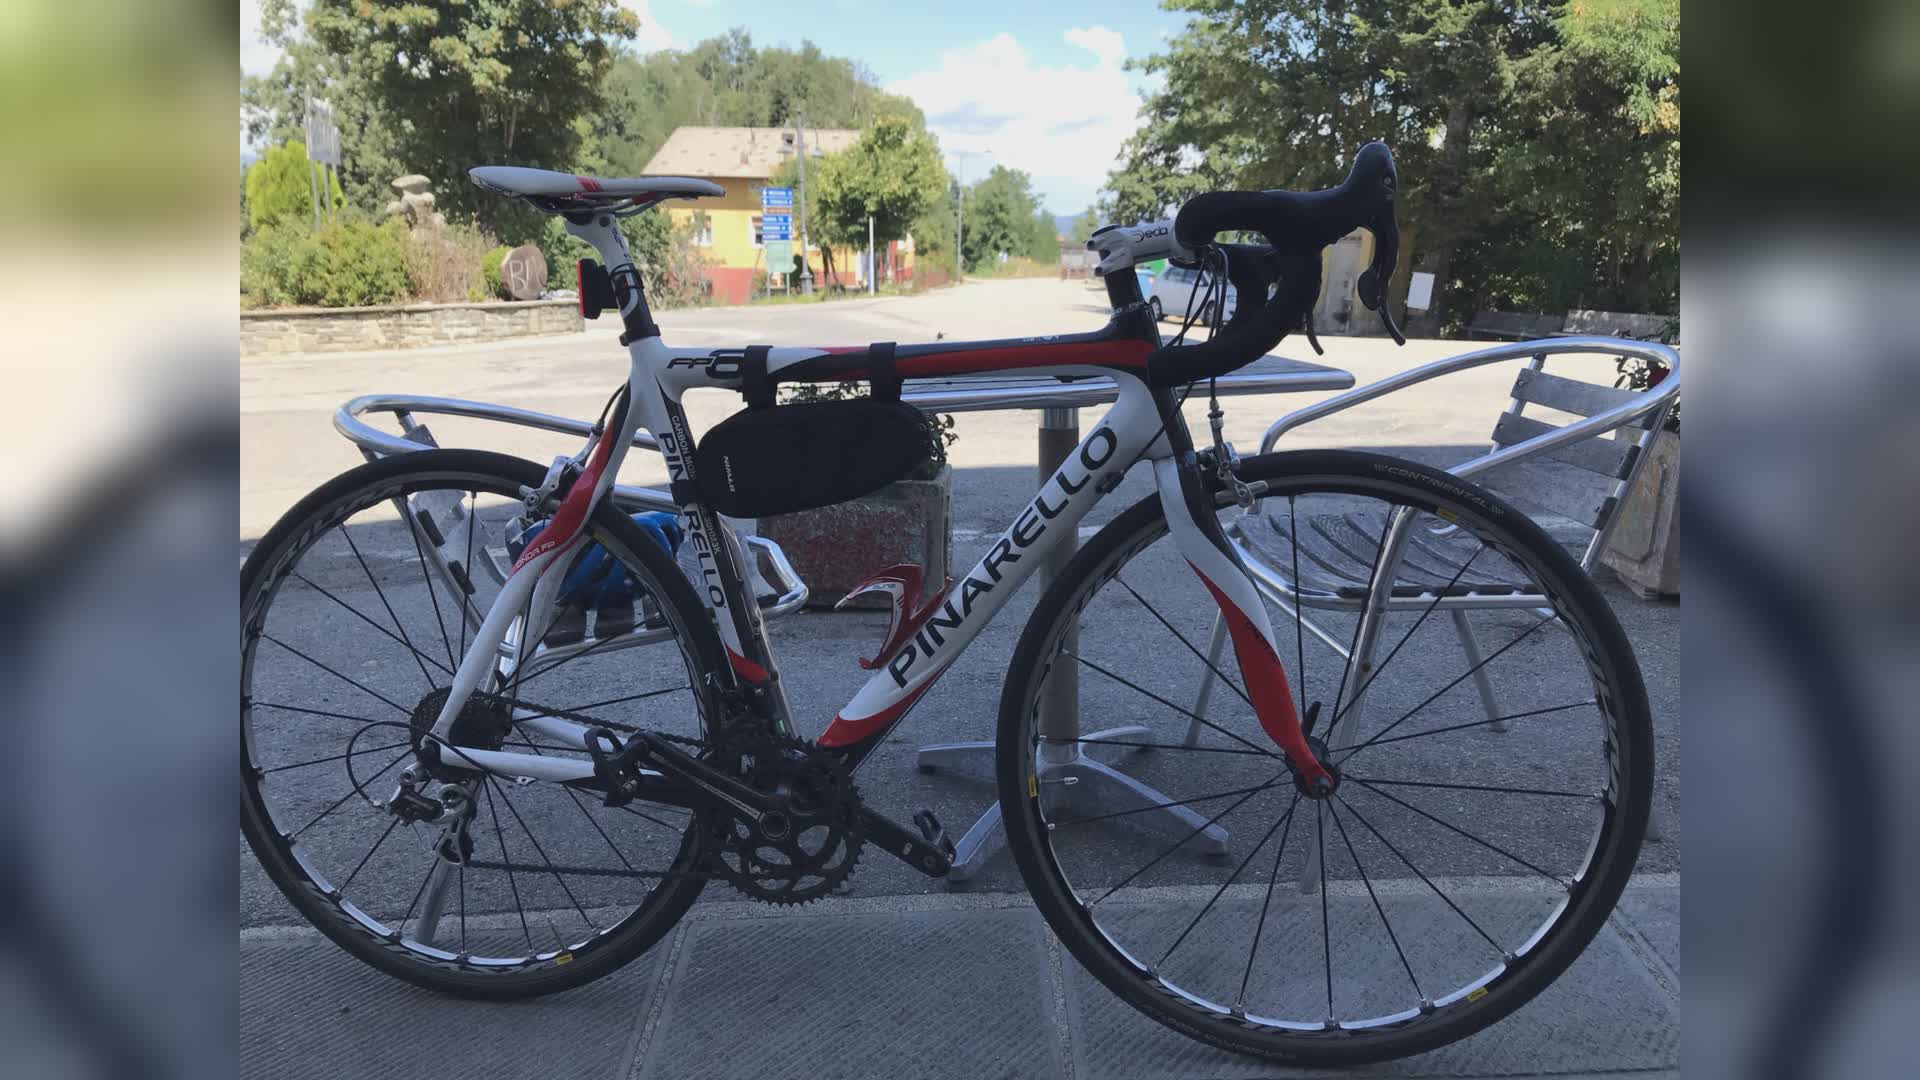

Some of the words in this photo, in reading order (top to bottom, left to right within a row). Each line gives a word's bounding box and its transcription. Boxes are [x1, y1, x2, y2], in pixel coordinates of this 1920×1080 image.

[672, 415, 690, 456] CARBON
[1387, 465, 1490, 508] CONTINENTAL
[659, 432, 726, 609] PINRELLO
[888, 427, 1117, 689] PINARELLO
